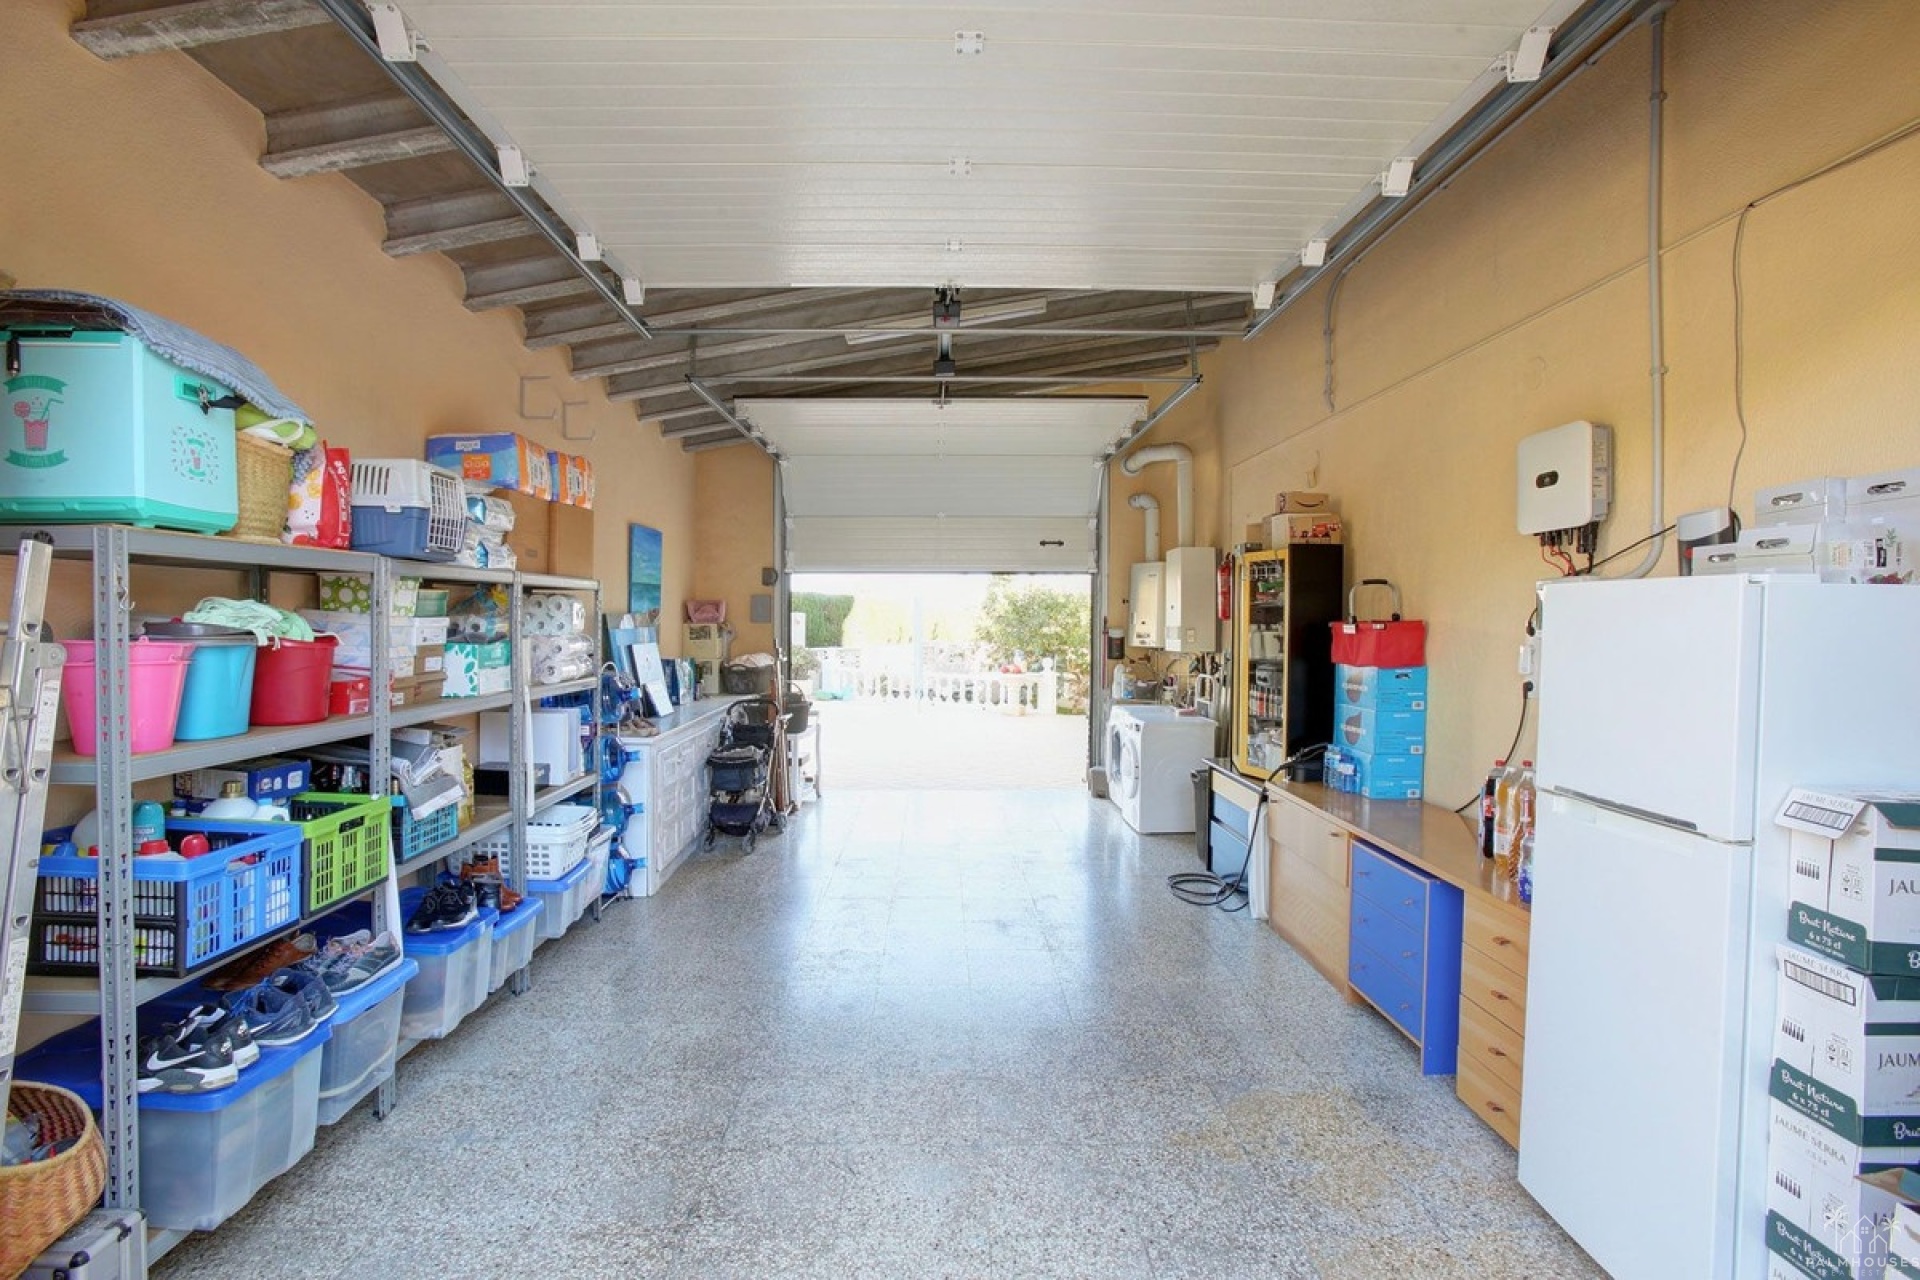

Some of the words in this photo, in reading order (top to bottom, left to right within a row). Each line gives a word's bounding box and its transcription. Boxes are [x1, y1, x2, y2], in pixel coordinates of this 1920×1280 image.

[1799, 911, 1821, 929] Brut
[1823, 920, 1856, 942] Nature
[1782, 1069, 1805, 1091] Brut
[1807, 1084, 1845, 1112] Nature
[1806, 1100, 1819, 1112] 75
[1776, 1115, 1806, 1140] JAUME
[1811, 1138, 1846, 1165] SERRA
